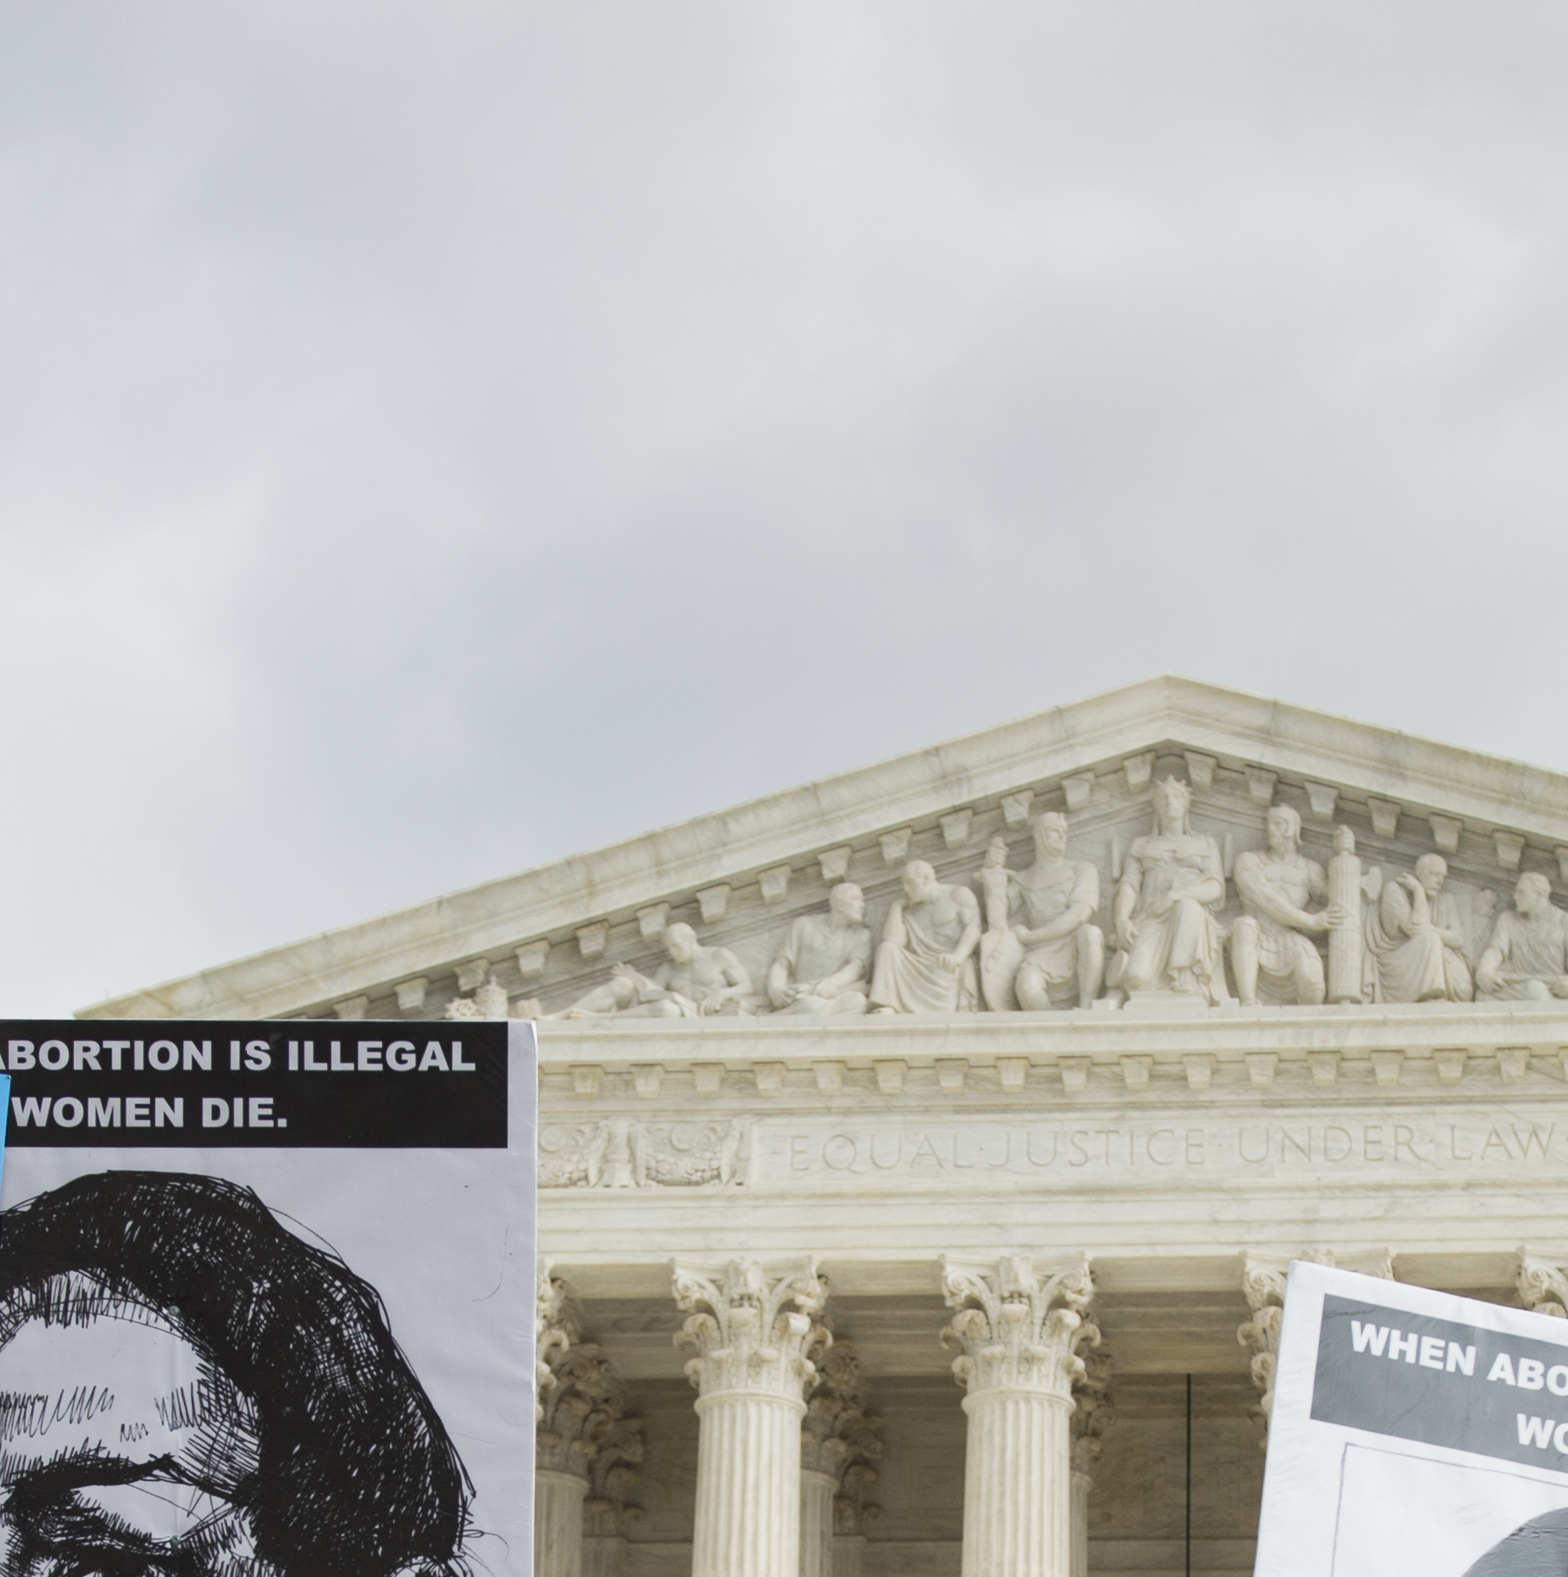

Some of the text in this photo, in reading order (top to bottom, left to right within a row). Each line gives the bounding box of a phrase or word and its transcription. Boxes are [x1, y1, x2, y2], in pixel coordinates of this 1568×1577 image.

[229, 1039, 272, 1071] IS
[287, 1039, 477, 1071] ILLEGAL
[11, 1096, 288, 1129] WOMEN DIE.
[789, 1121, 1558, 1175] EQUAL JUSTICE UNDER LAW
[1349, 1320, 1477, 1376] WHEN
